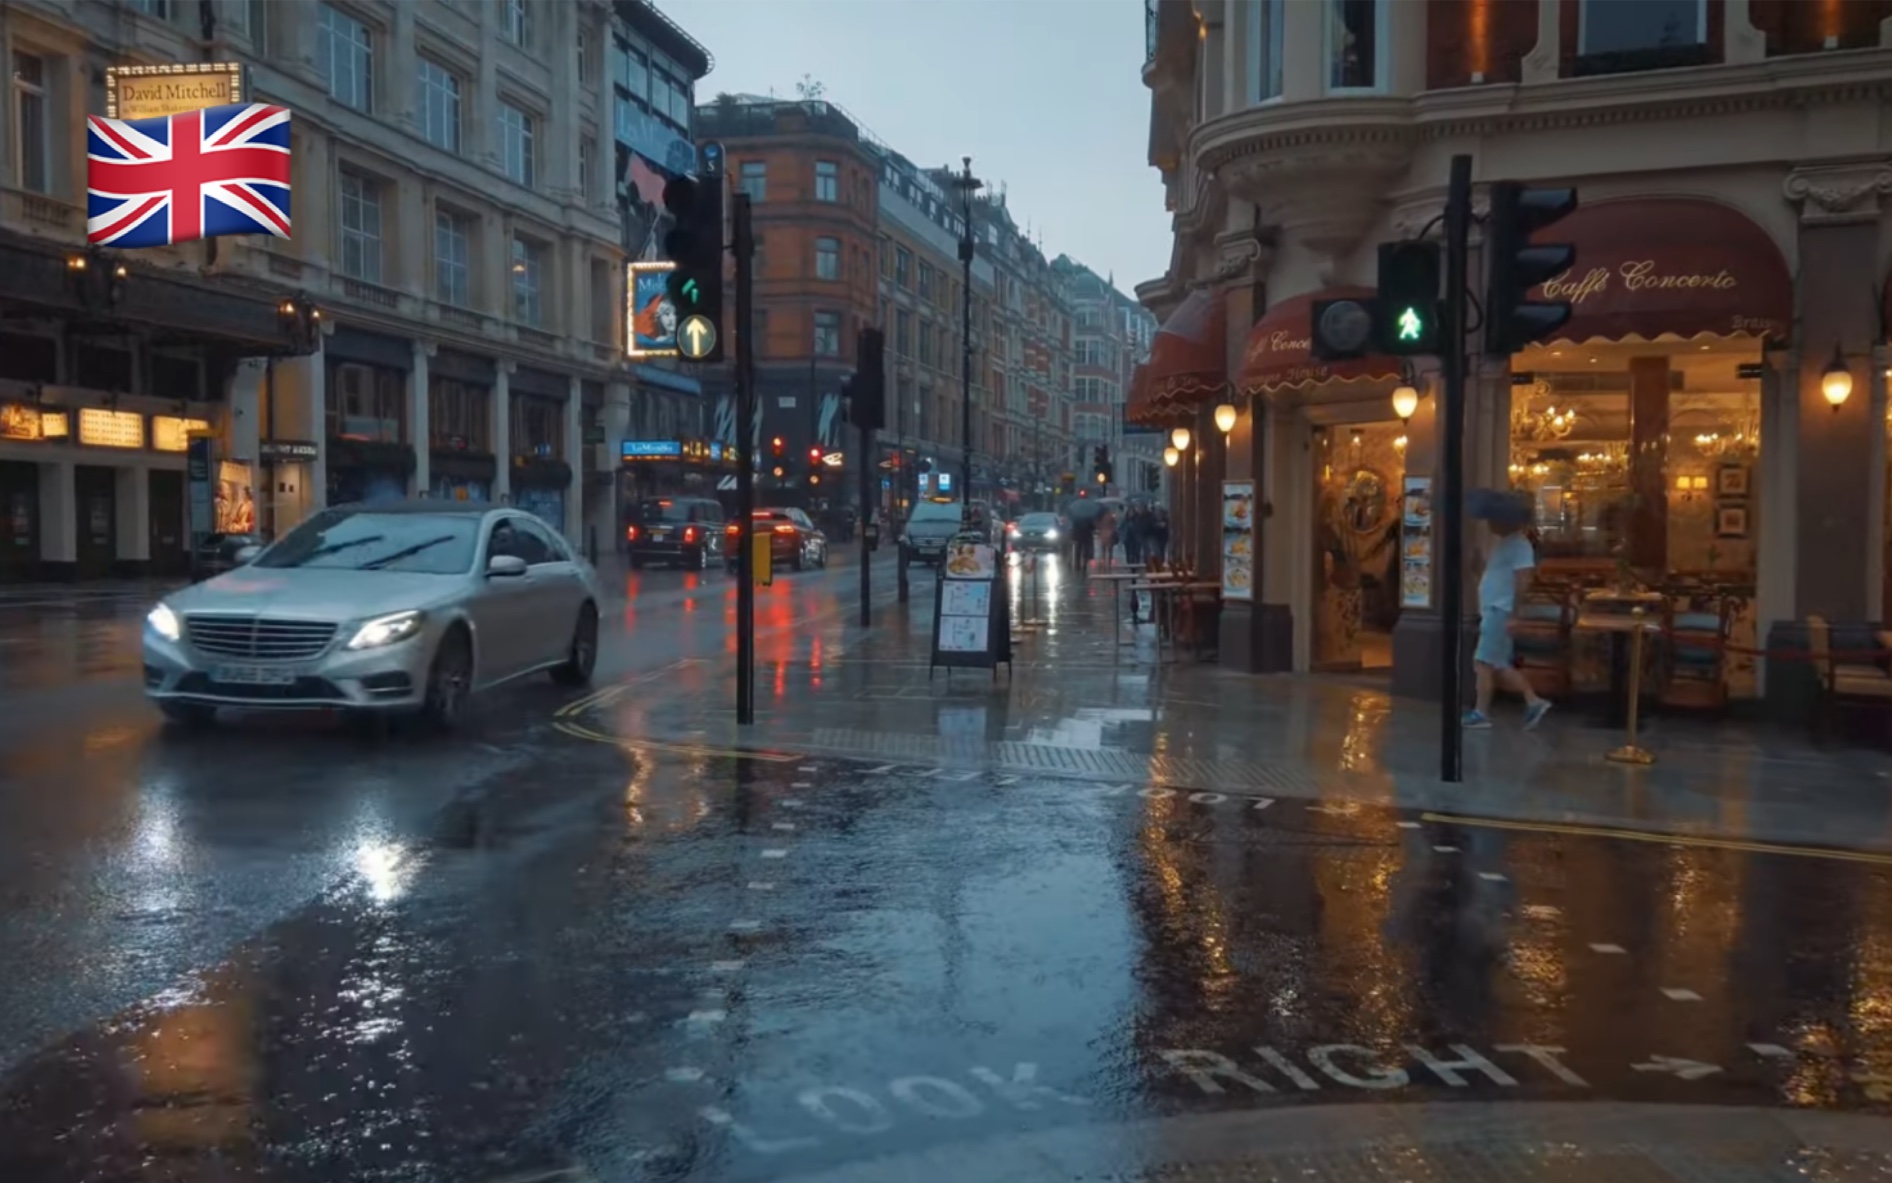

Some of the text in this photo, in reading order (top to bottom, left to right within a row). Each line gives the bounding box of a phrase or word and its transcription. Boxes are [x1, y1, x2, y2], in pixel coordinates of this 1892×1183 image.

[122, 82, 226, 101] David Mitchell
[1618, 259, 1738, 292] Concerto
[700, 1042, 1592, 1154] LOOK RIGHT
